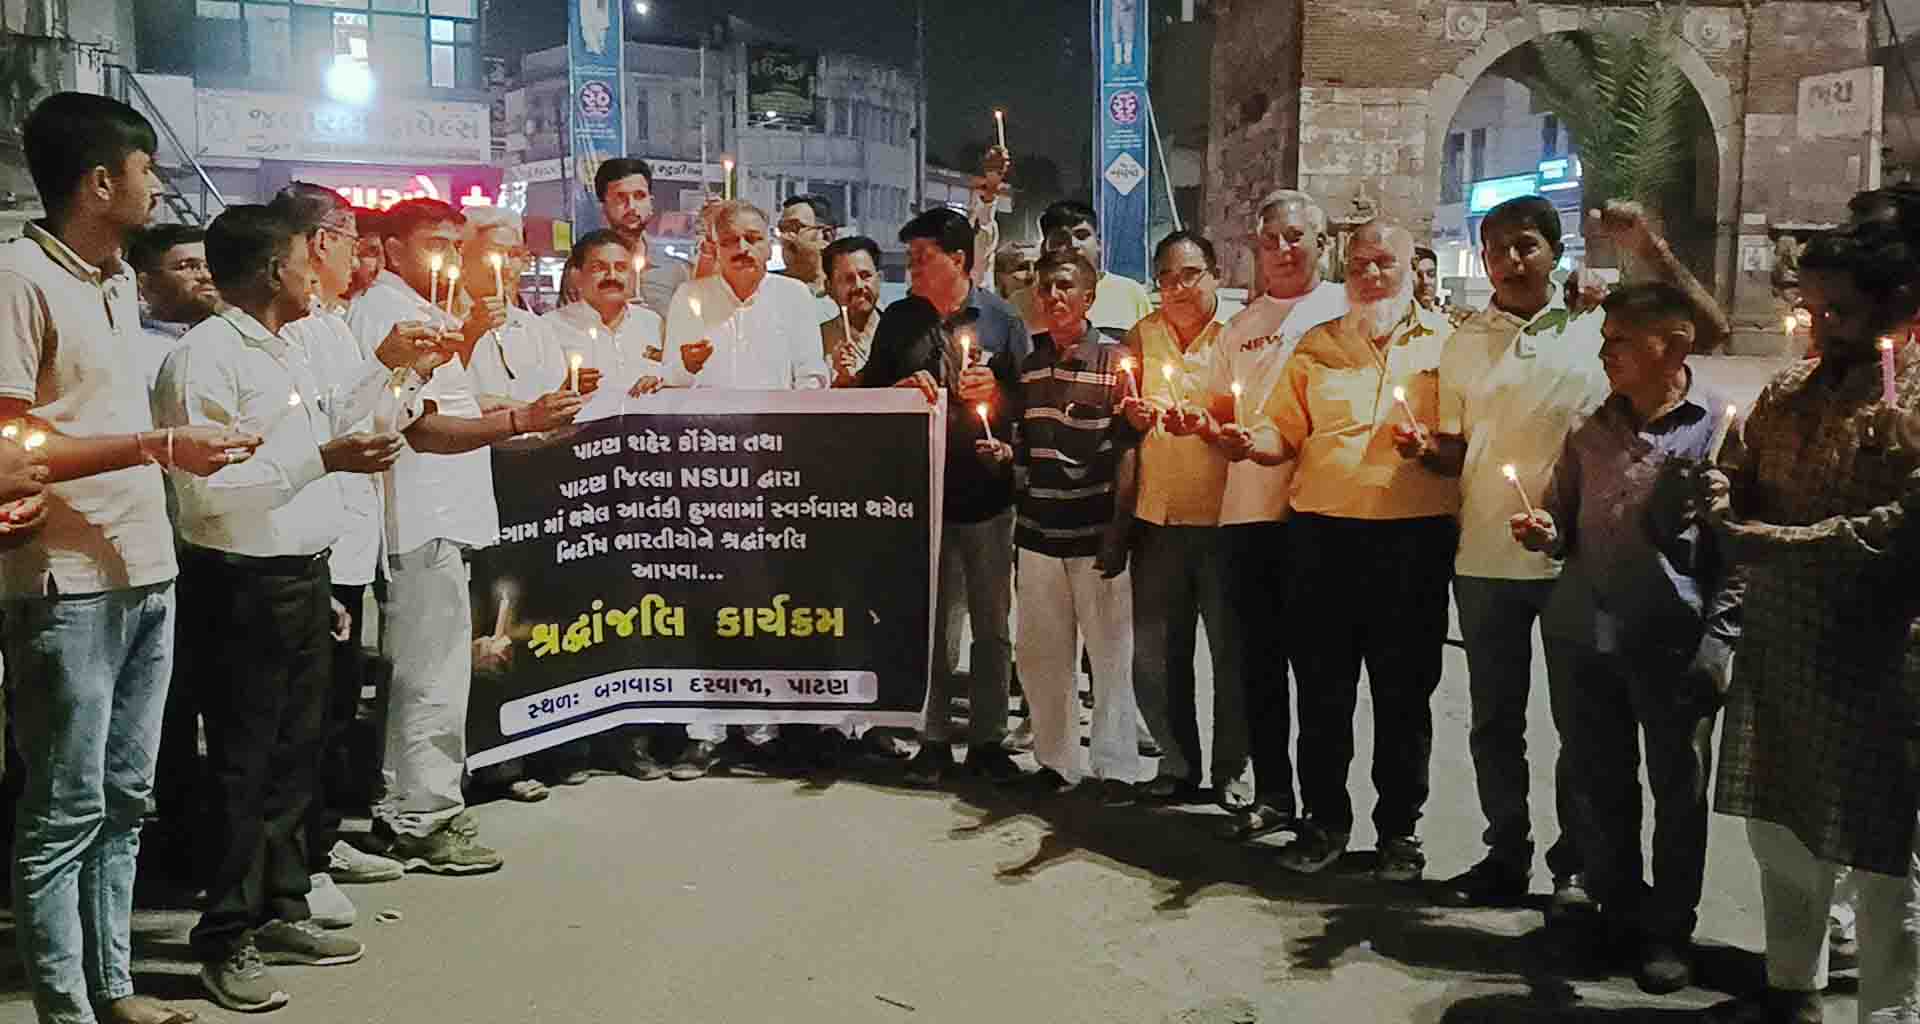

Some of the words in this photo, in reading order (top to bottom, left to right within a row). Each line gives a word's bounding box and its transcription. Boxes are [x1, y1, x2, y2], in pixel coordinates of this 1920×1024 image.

[573, 436, 621, 460] પાટણ
[627, 429, 672, 453] શહેર
[744, 433, 783, 452] તથા
[559, 474, 607, 499] પાટણ
[613, 466, 673, 488] જિલ્લા
[680, 467, 749, 488] NSUI
[757, 469, 801, 489] દ્વારા
[543, 509, 564, 533] માં
[569, 503, 610, 527] થયેલ
[616, 496, 681, 518] આતંકી
[688, 496, 764, 525] હુમલામાં
[770, 496, 858, 518] સ્વર્ગવાસ
[865, 496, 914, 518] થયેલ
[557, 532, 609, 563] નિર્દોષ
[614, 527, 714, 550] ભારતીયોને
[631, 563, 724, 580] આપવા...
[594, 676, 673, 699] બગવાડા
[689, 677, 771, 697] દરવાજા,
[787, 677, 849, 696] પાટણ
